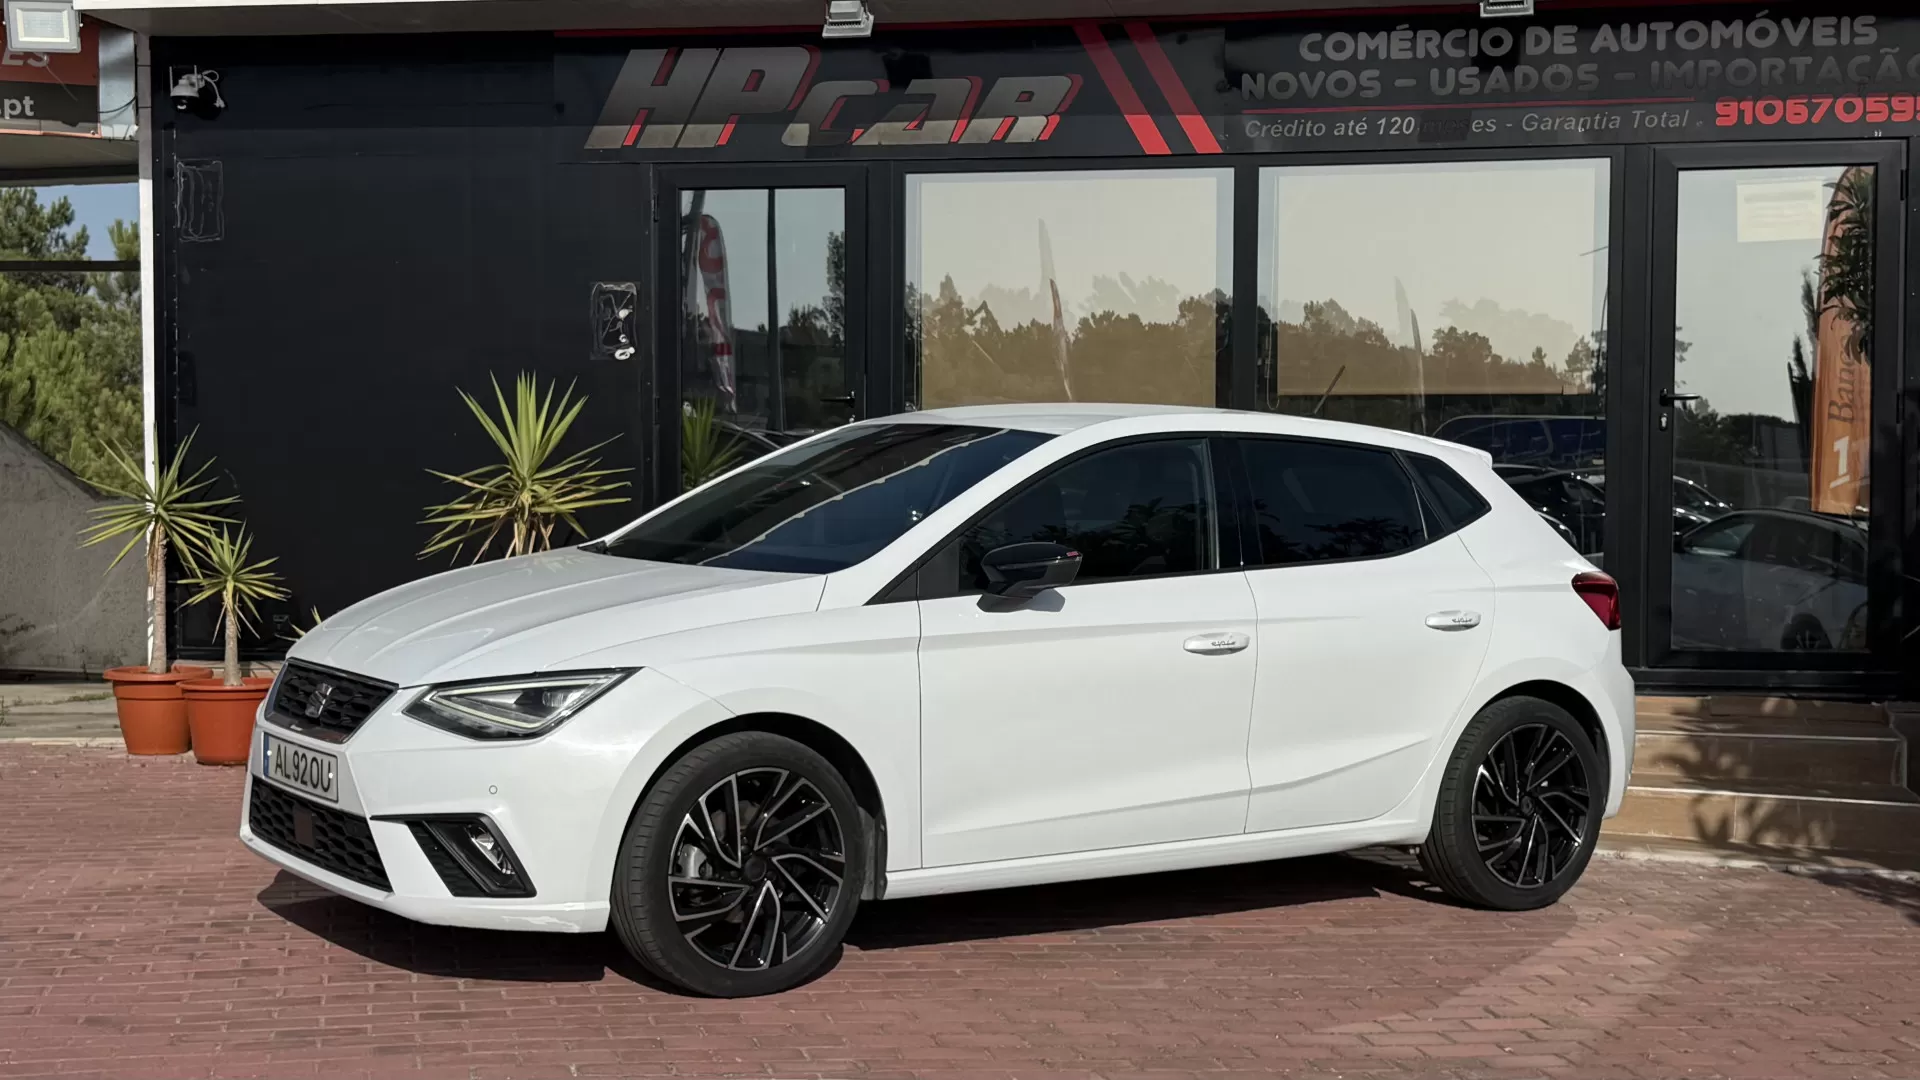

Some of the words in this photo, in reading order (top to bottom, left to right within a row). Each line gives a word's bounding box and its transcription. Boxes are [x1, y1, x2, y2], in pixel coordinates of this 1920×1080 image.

[1299, 24, 1513, 62] COMÉRCIO
[1525, 24, 1578, 56] DE
[1590, 9, 1878, 54] AUTOMÓVEIS
[1241, 68, 1382, 101] NOVOS
[1429, 63, 1599, 96] USADOS
[1244, 117, 1326, 139] Crédito
[1333, 117, 1368, 137] até
[1376, 116, 1415, 136] 120
[1521, 112, 1621, 134] Garantia
[1631, 109, 1690, 129] Total
[1715, 92, 1920, 126] 91067059
